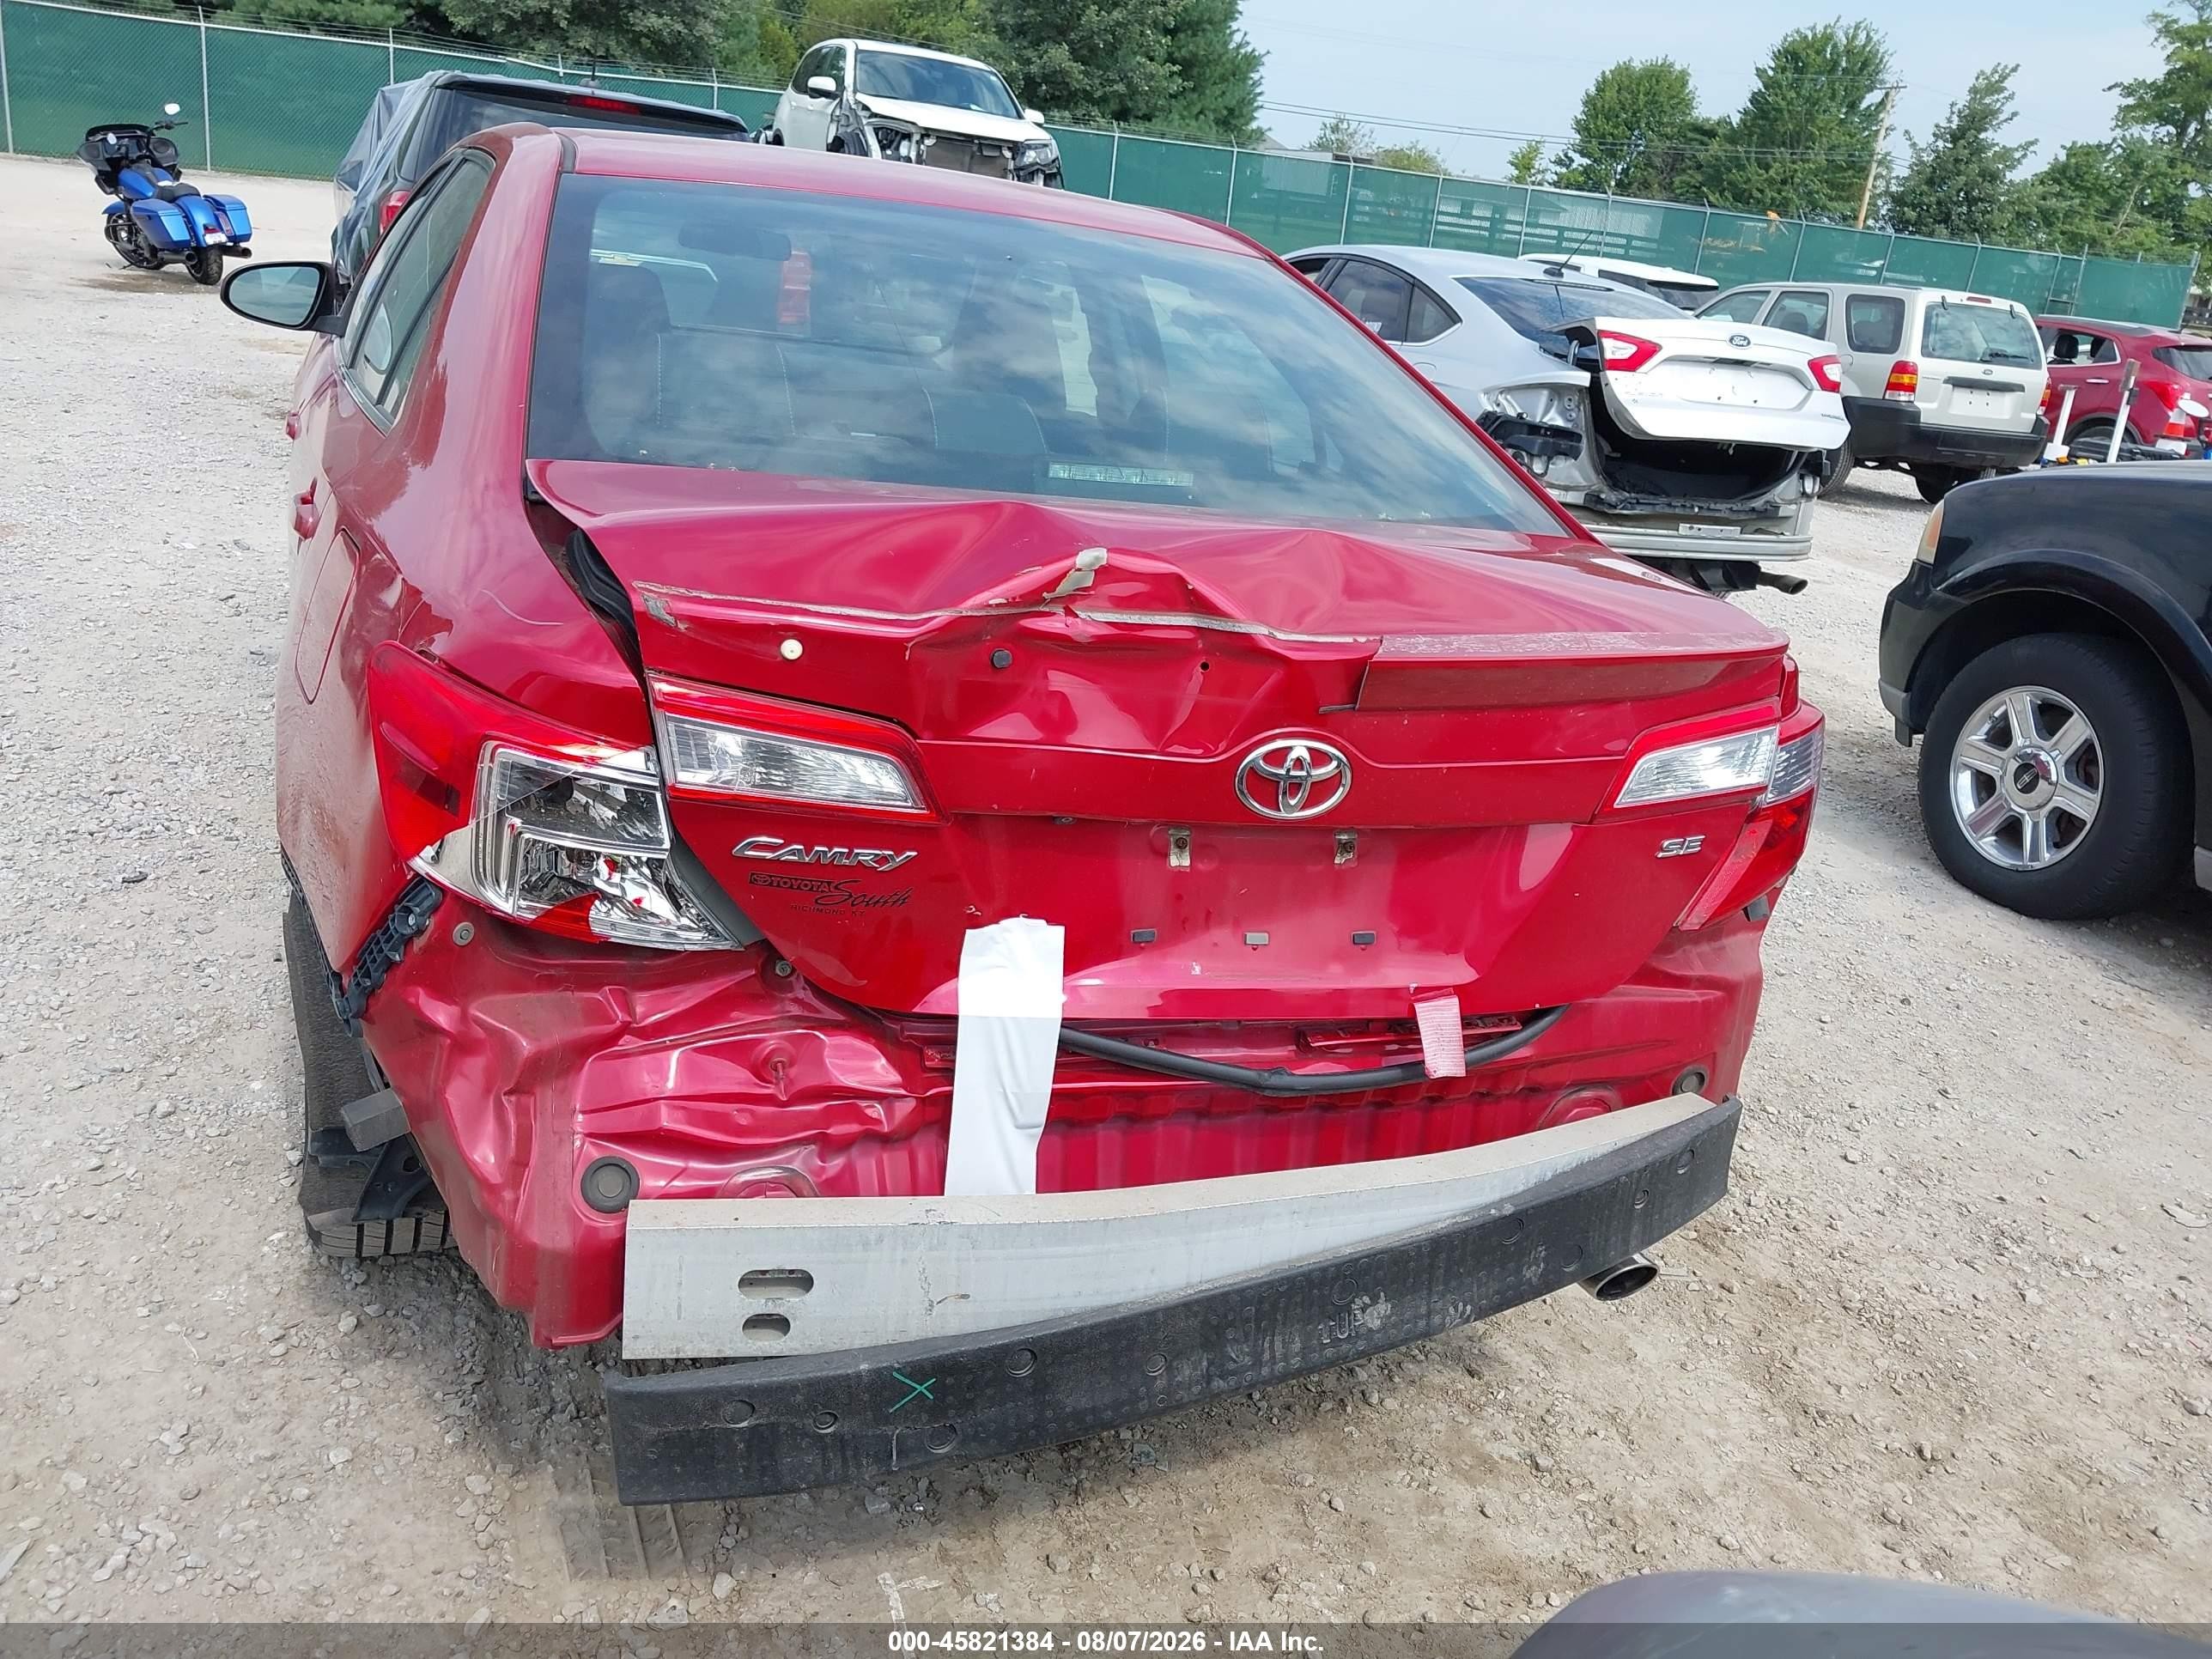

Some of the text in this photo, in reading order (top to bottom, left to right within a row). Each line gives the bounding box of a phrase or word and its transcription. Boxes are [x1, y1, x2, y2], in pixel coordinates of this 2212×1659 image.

[732, 836, 918, 872] CAMRY
[1655, 835, 1706, 858] SE
[770, 876, 913, 908] TOYOTA South
[791, 904, 845, 916] RICHMOND
